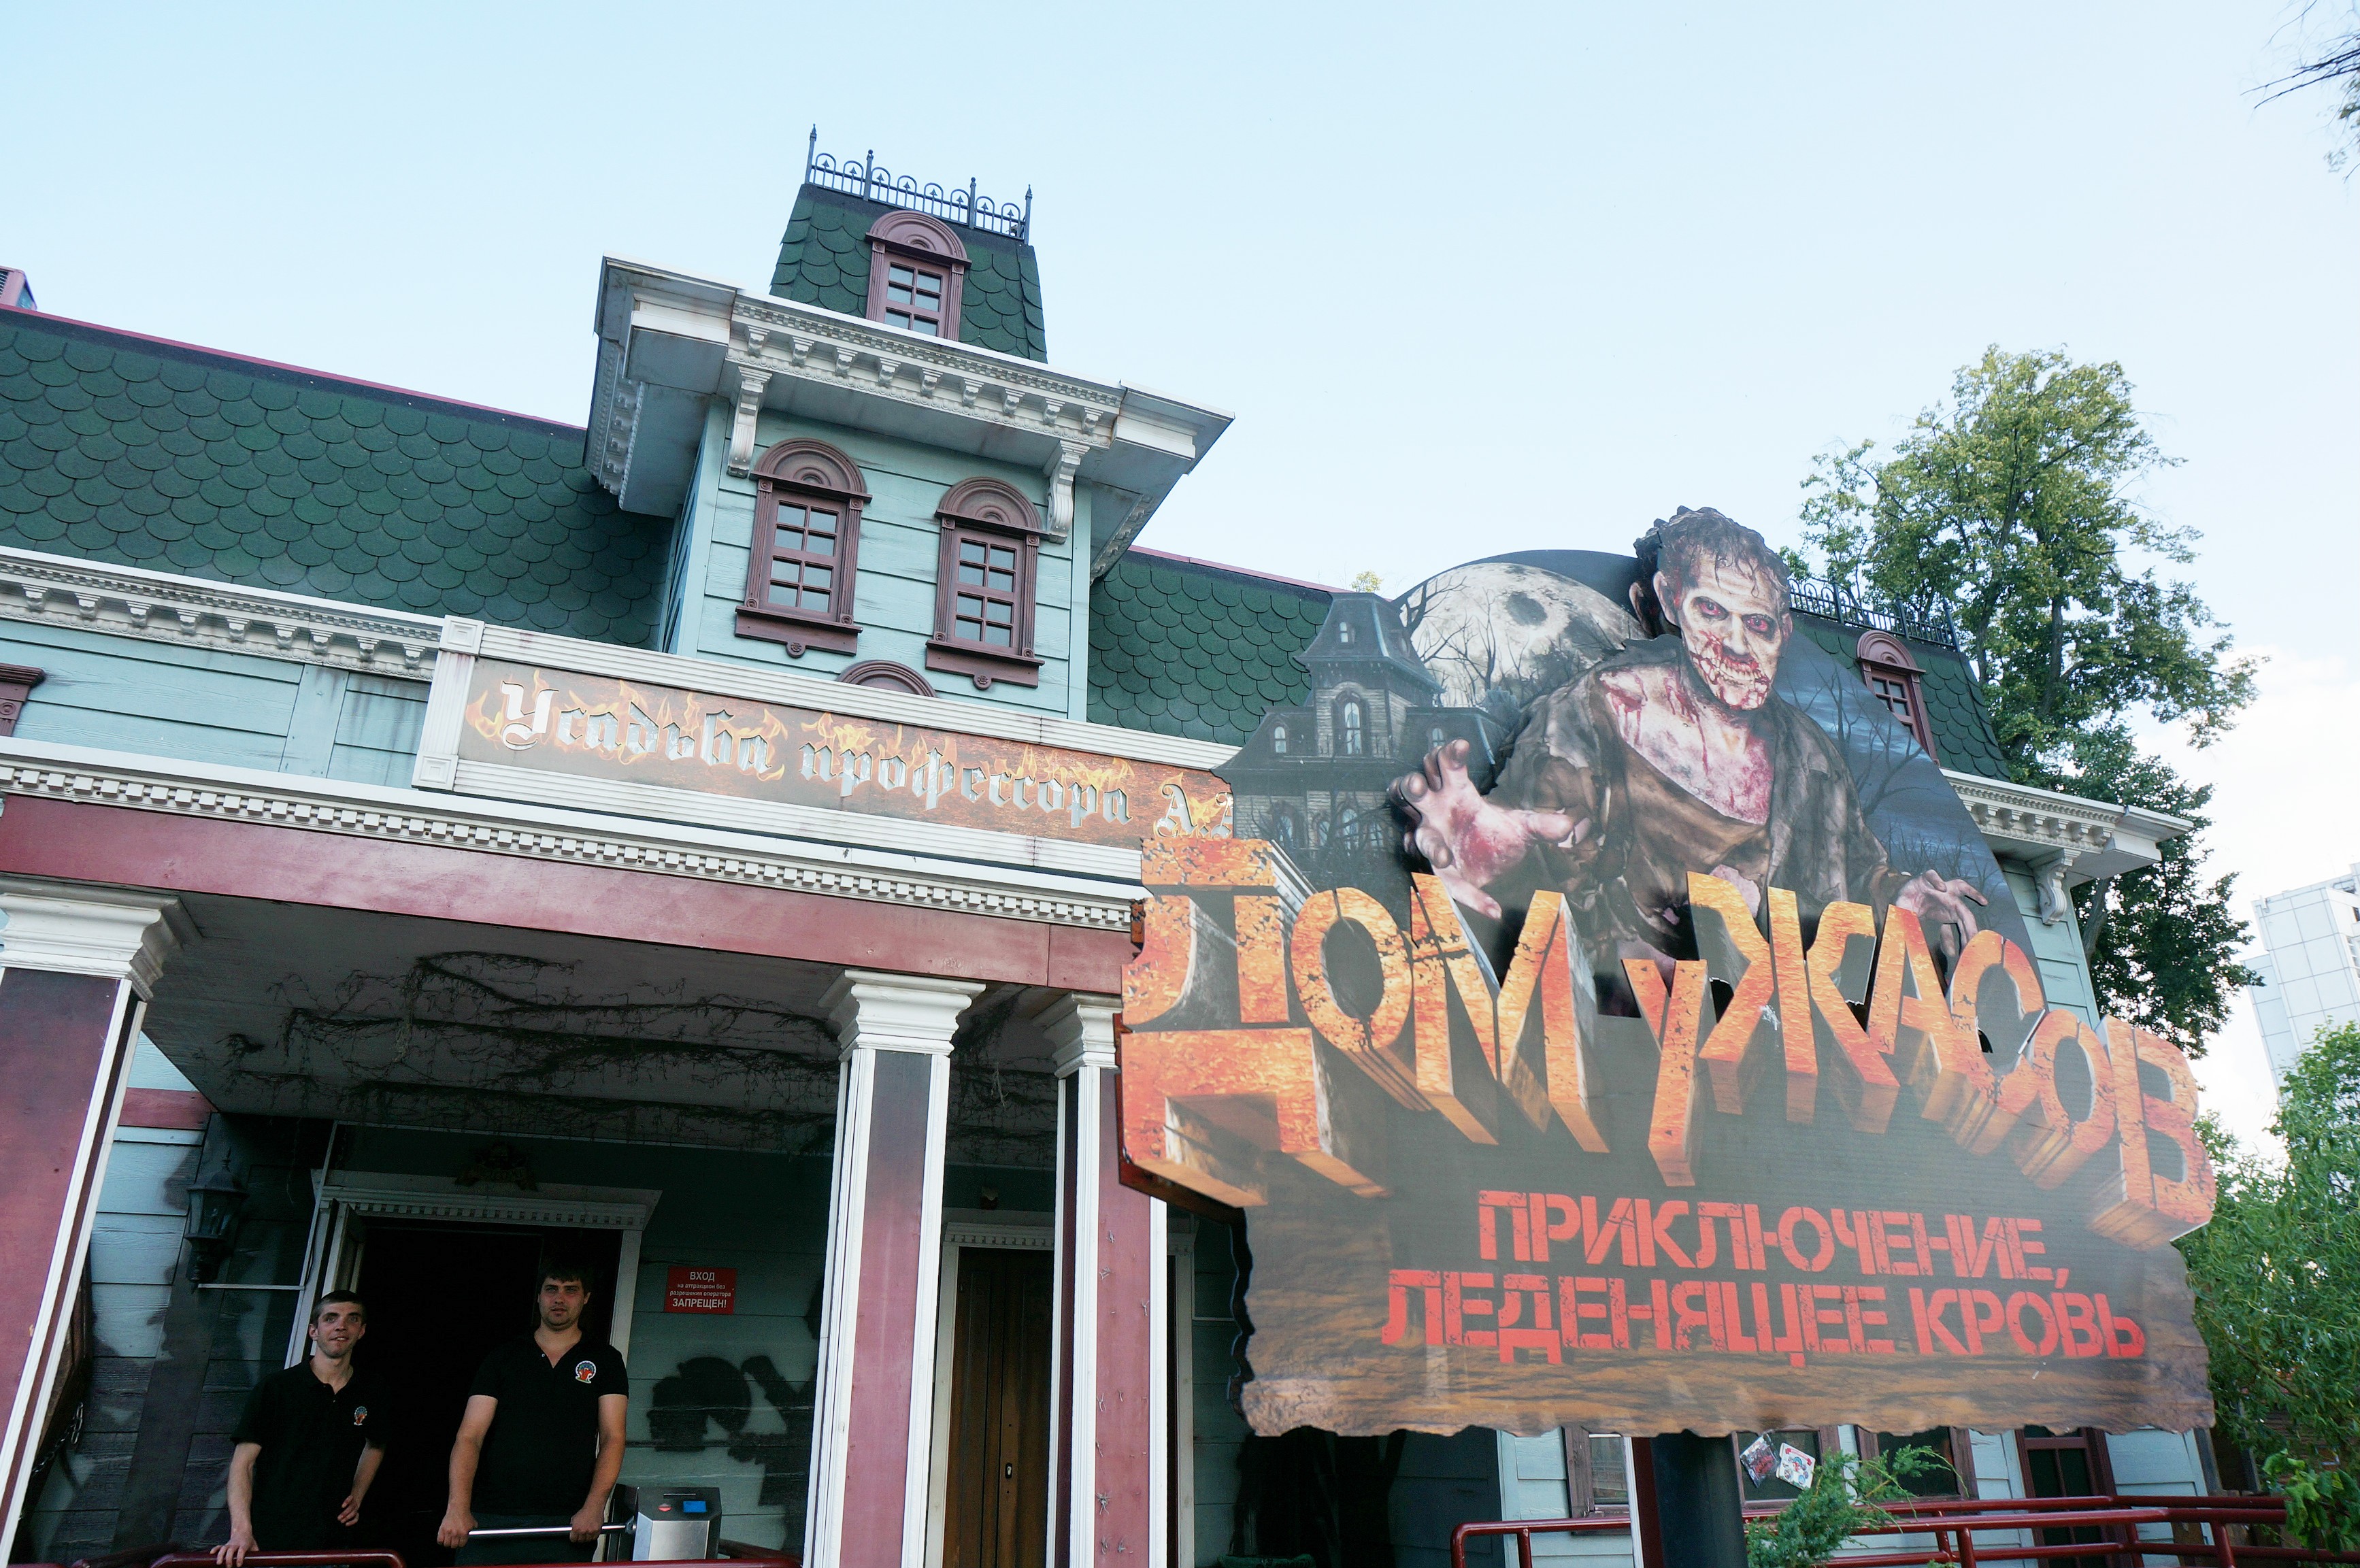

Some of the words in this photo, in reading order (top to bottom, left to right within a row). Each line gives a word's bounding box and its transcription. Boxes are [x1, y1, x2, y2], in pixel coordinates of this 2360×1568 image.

[501, 681, 772, 774] Усадьба
[798, 741, 1133, 829] профессора
[1120, 837, 1595, 1177] ДОМ
[1621, 871, 2216, 1231] УЖАСОВ
[689, 1271, 715, 1282] ВХОД
[1478, 1189, 2070, 1290] ПРИКЛЮЧЕНИЕ,
[672, 1298, 727, 1309] ЗАПРЕЩЕН!
[1380, 1269, 1895, 1367] ЛЕДЕНЯЩЕЕ
[1908, 1286, 2145, 1358] КРОВЬ
